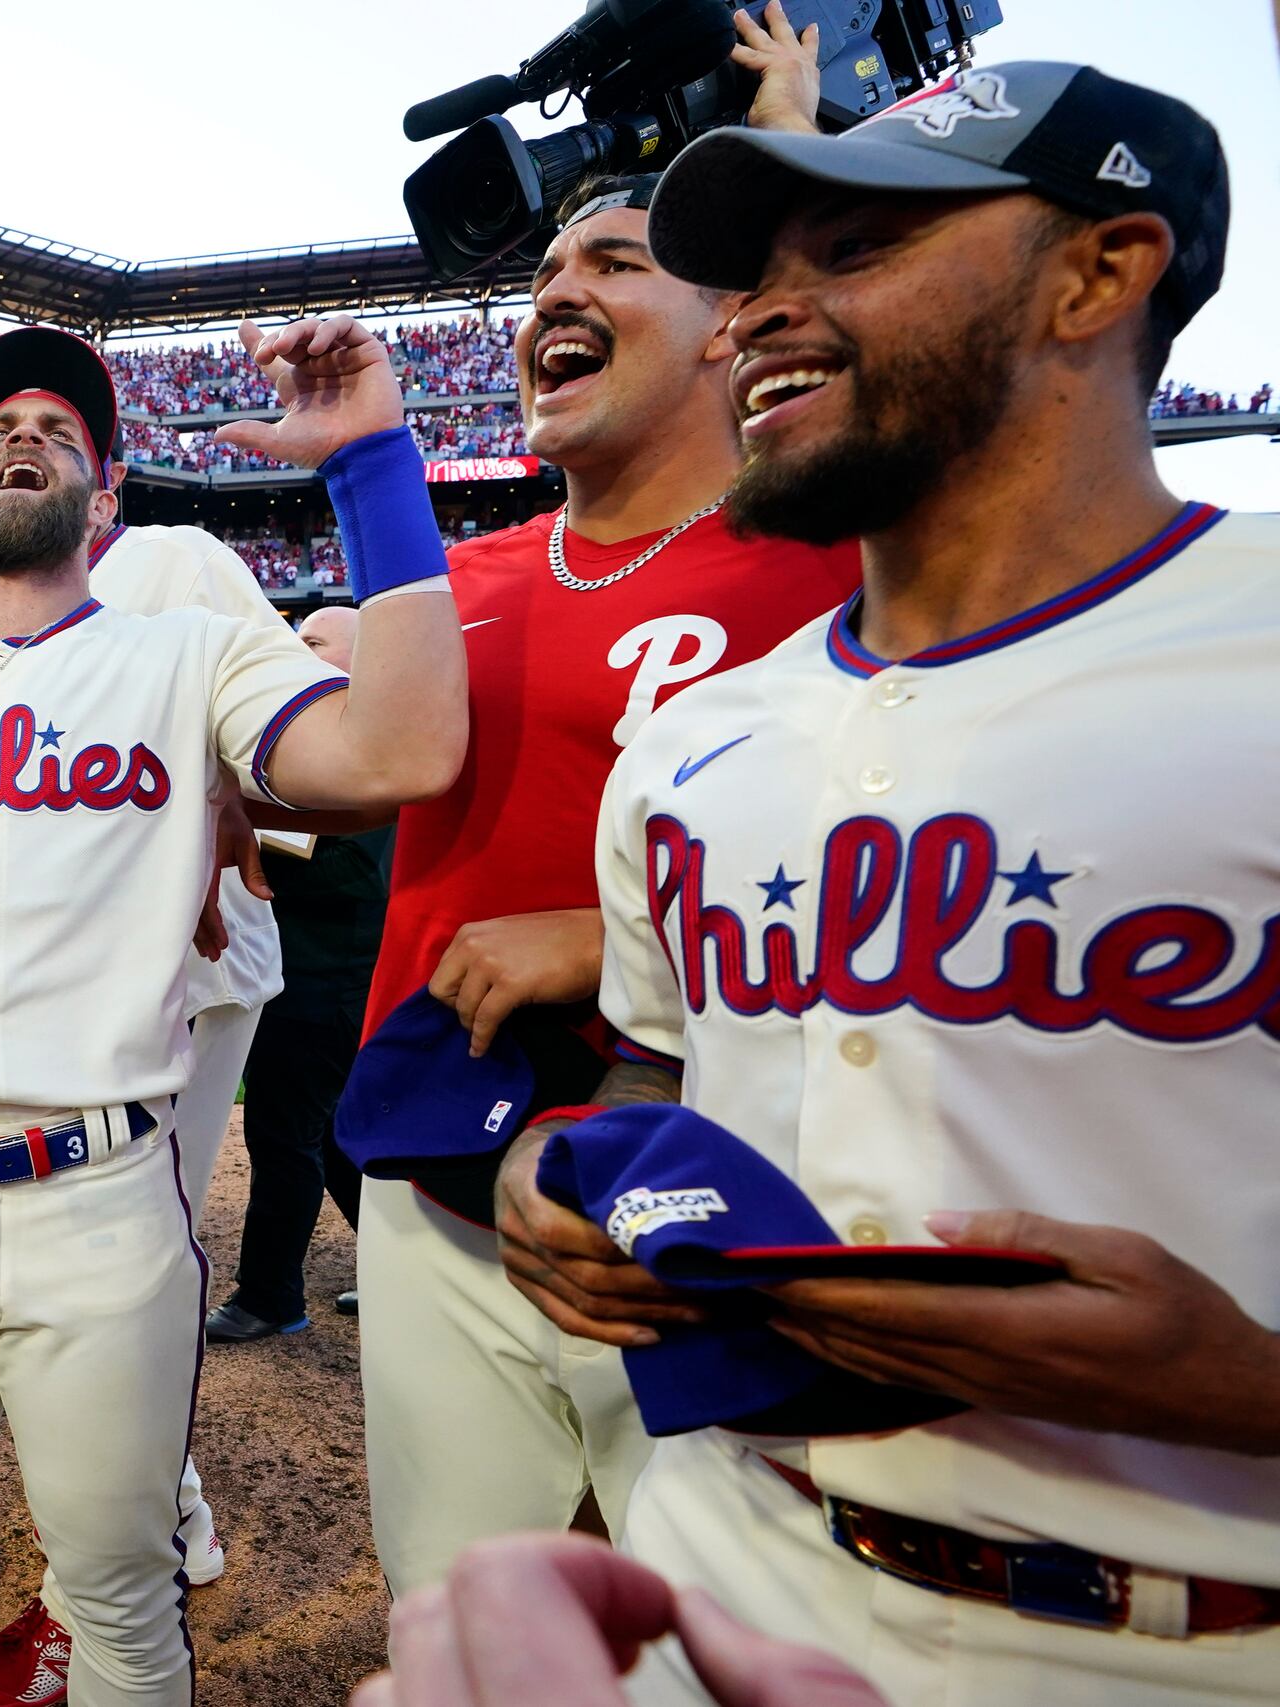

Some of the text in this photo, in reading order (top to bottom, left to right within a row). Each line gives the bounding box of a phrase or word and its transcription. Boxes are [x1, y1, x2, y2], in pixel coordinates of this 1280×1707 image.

[641, 139, 657, 155] 22
[607, 614, 728, 748] P
[646, 812, 1280, 1043] Phillie
[68, 1136, 84, 1160] 3
